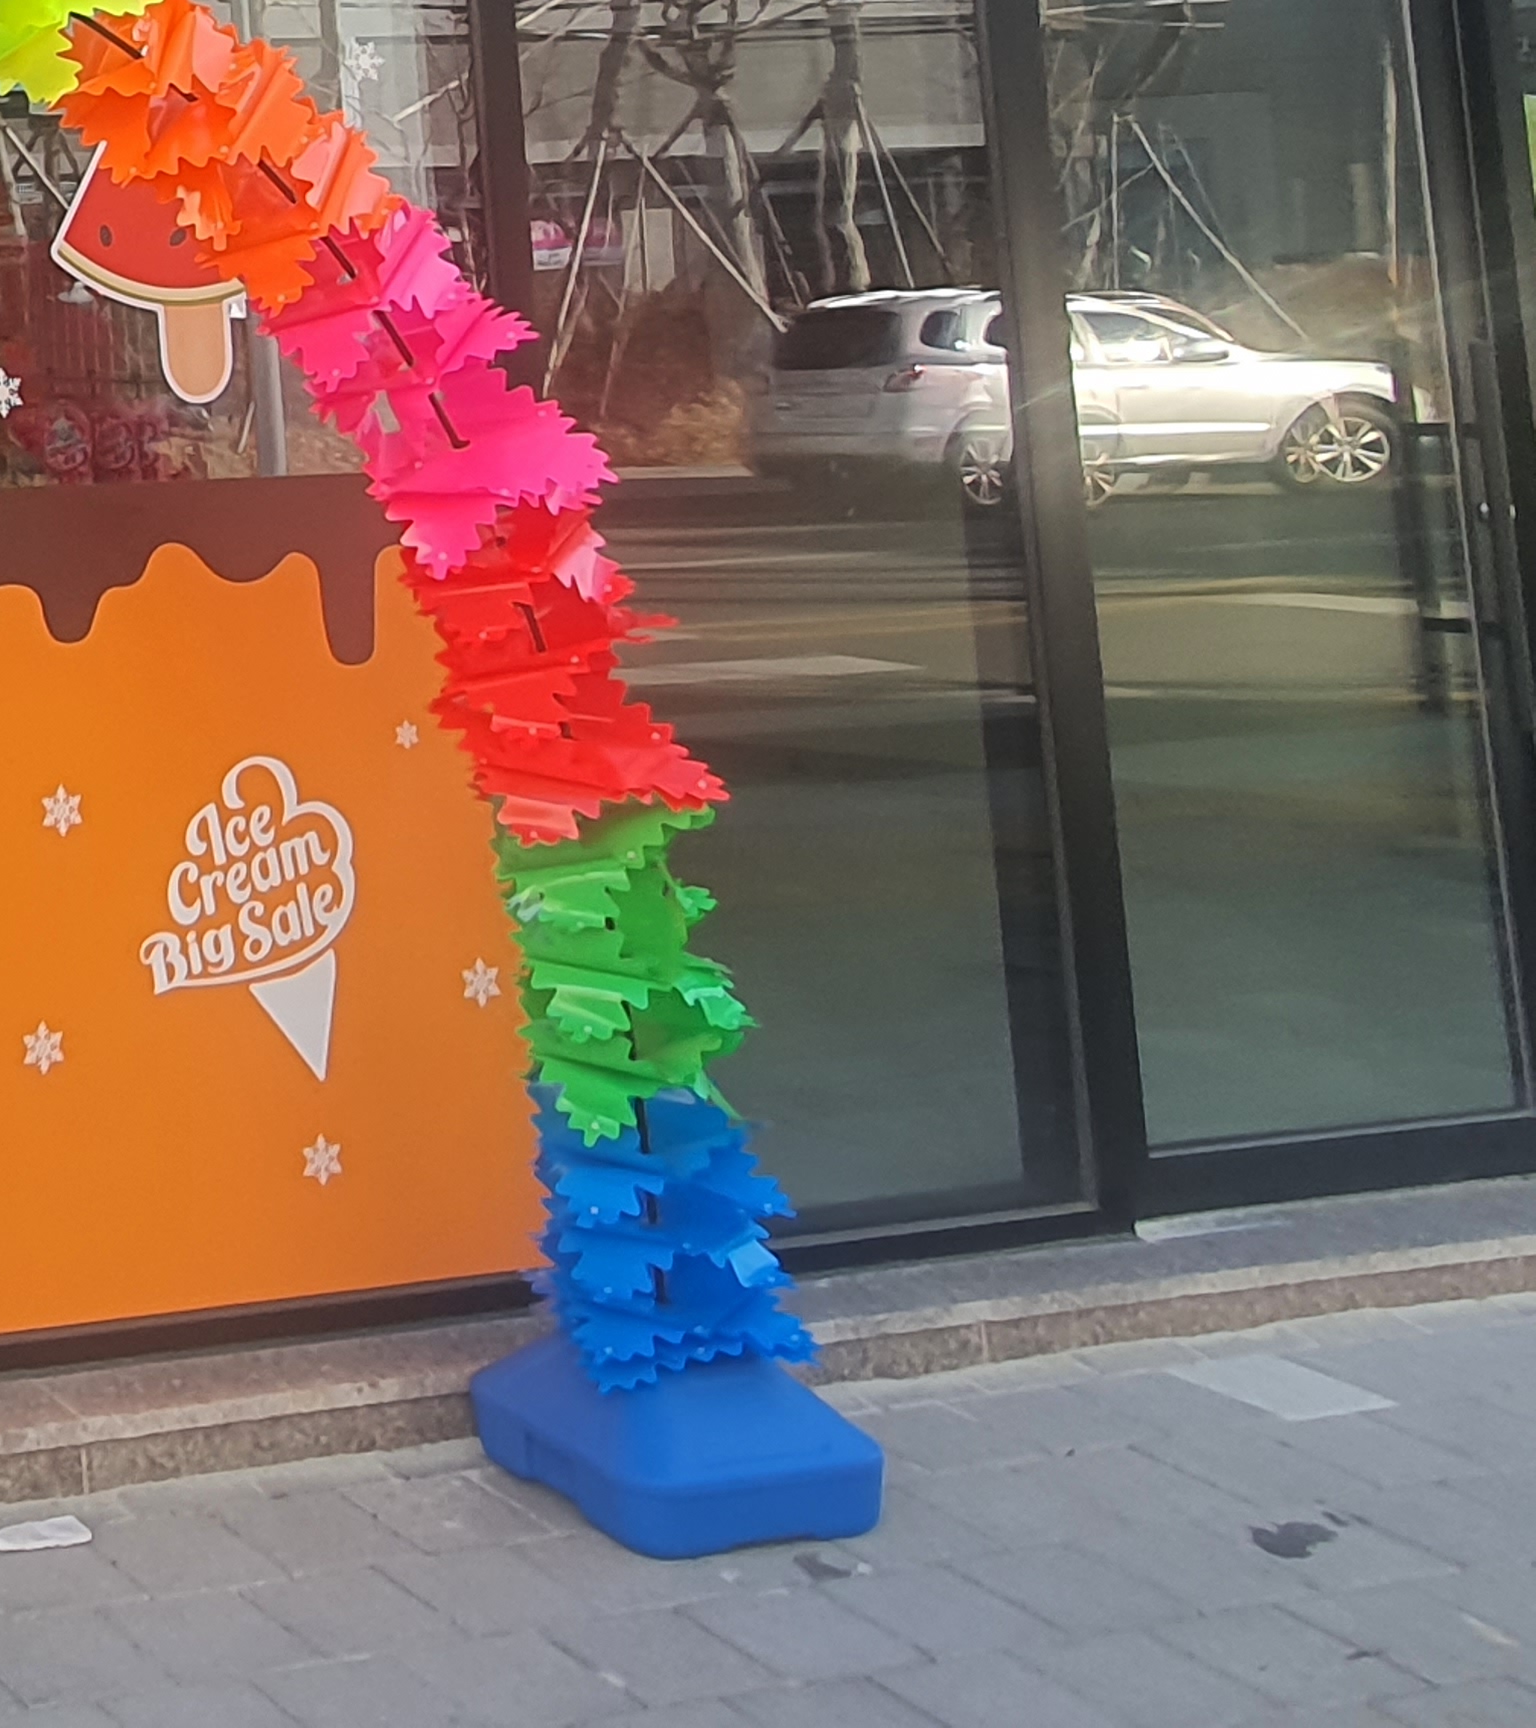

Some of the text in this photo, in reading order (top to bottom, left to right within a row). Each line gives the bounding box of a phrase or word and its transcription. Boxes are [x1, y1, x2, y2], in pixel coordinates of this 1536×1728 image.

[167, 830, 330, 926] Cream
[185, 803, 275, 865] Ice
[139, 882, 340, 995] Big Sale
